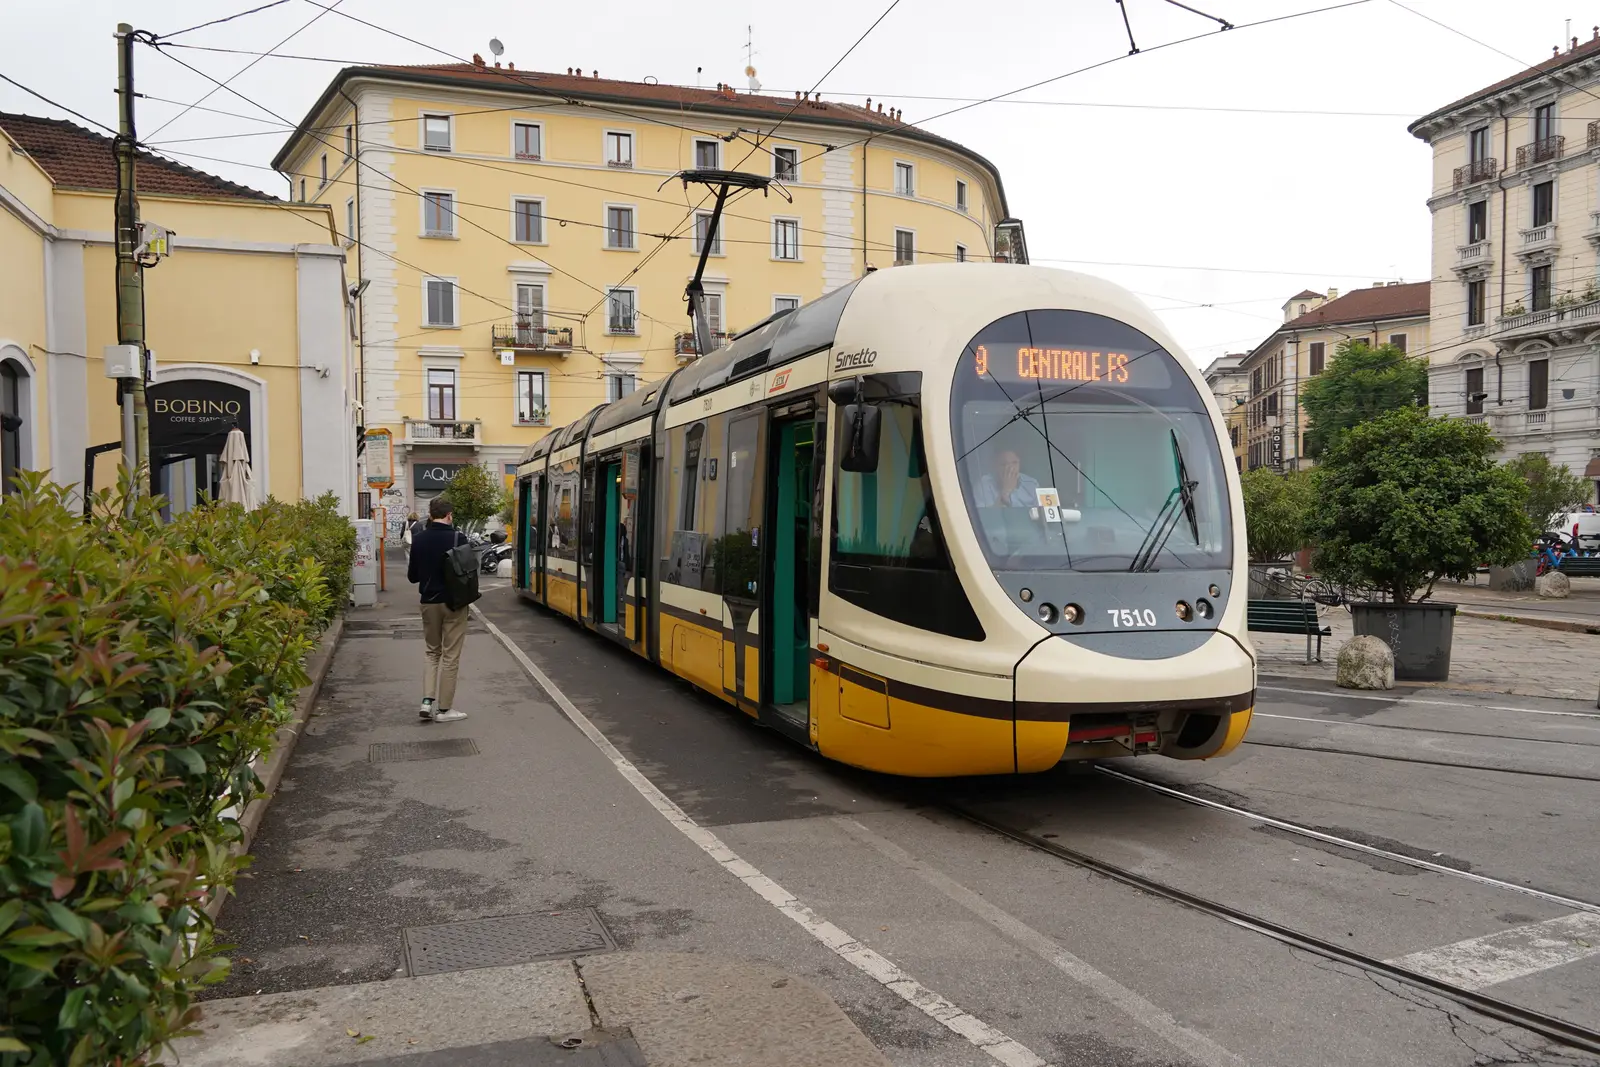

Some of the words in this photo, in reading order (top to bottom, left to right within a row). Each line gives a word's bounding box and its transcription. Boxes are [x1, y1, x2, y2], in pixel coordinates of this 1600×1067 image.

[975, 345, 987, 376] 9
[1018, 347, 1101, 381] CENTRALE
[1107, 352, 1129, 383] FS
[154, 399, 241, 414] BOBINO
[1045, 495, 1052, 506] 5
[1048, 508, 1055, 519] 9
[1107, 608, 1157, 628] 7510
